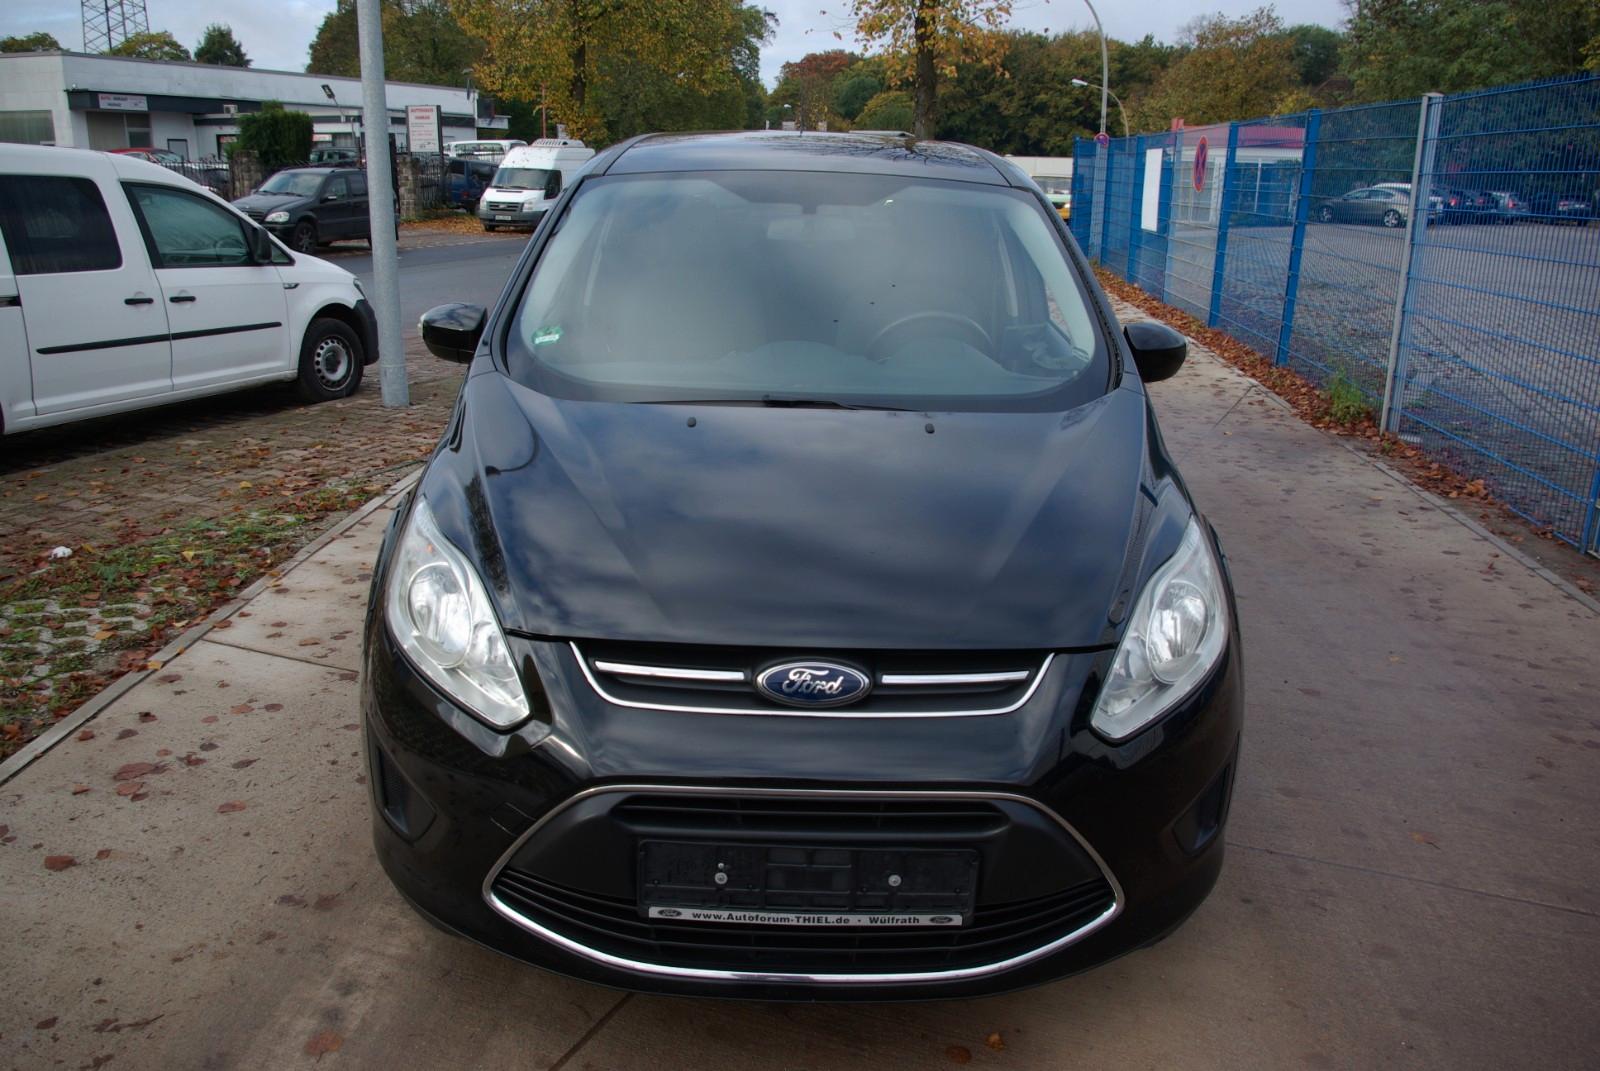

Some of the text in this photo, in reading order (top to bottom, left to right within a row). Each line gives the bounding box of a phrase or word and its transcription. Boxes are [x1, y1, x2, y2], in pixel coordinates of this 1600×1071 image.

[782, 668, 845, 695] Ford
[692, 912, 850, 925] www.Autoforum-THIEL.de
[868, 916, 920, 925] Wülfrath
